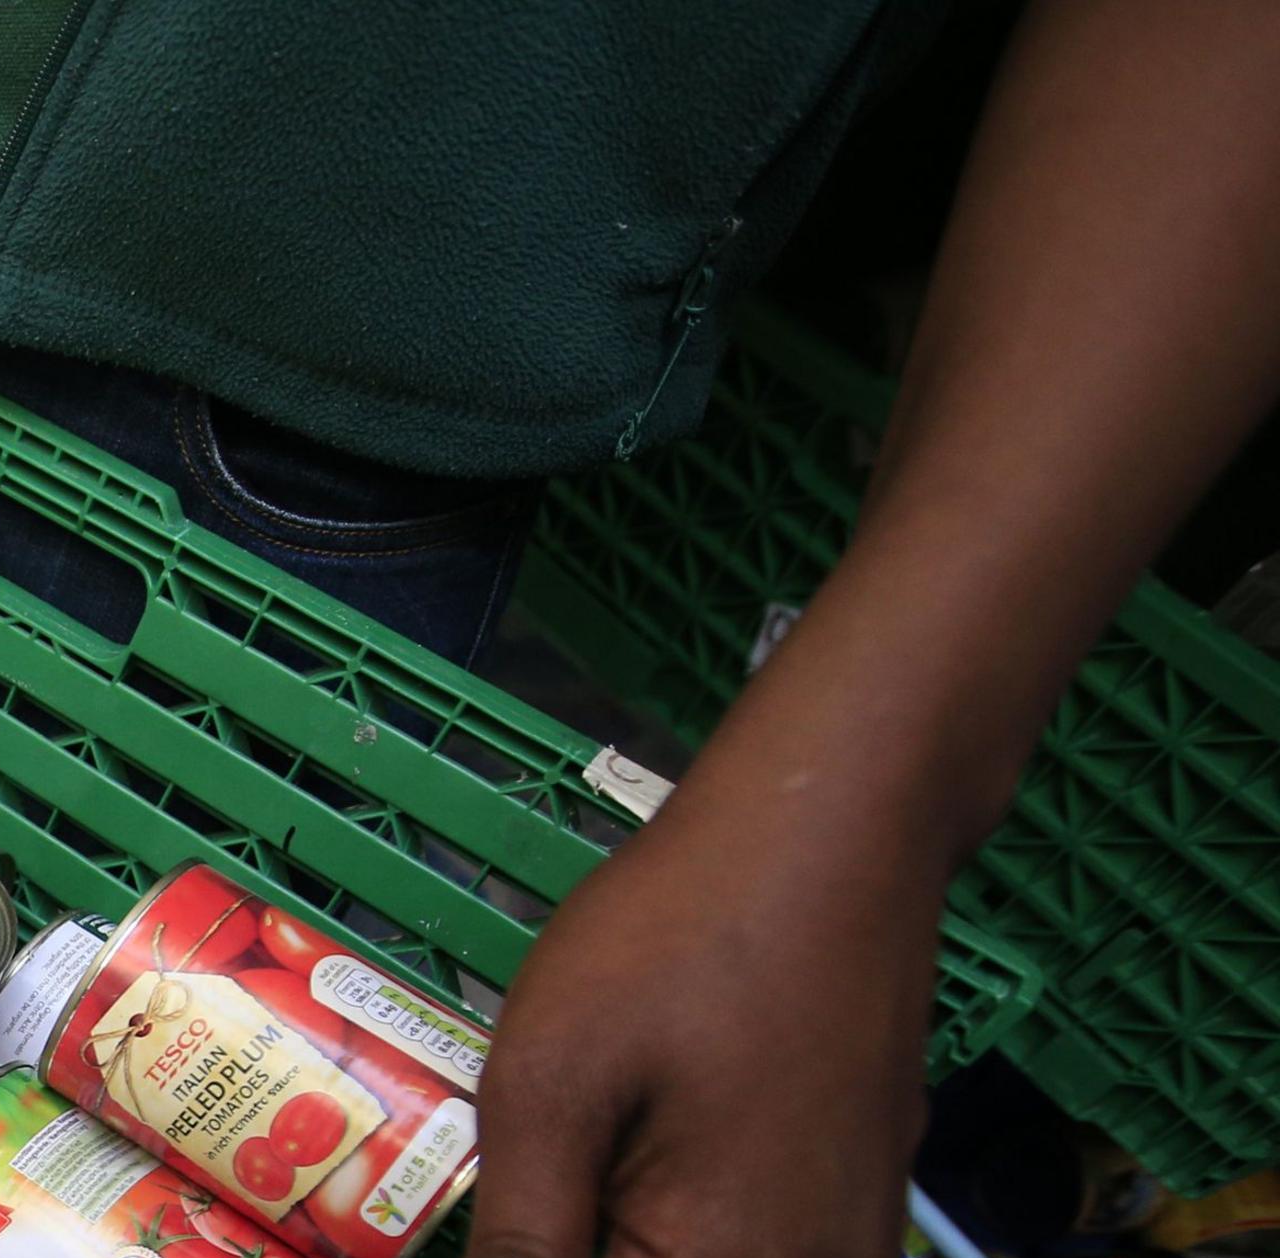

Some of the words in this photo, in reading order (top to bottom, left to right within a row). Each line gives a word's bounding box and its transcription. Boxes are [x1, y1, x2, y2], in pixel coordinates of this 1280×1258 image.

[143, 1018, 208, 1085] TESCO
[165, 1080, 226, 1144] PEELED
[220, 1024, 284, 1086] PLUM
[172, 1045, 228, 1103] ITALIAN
[201, 1069, 270, 1137] TOMATOES
[204, 1147, 217, 1161] in
[214, 1134, 232, 1154] rich
[229, 1098, 269, 1136] tomato
[267, 1064, 302, 1097] sauce
[390, 1182, 405, 1195] 1
[398, 1166, 417, 1186] of
[410, 1153, 426, 1169] 5
[430, 1117, 457, 1147] day
